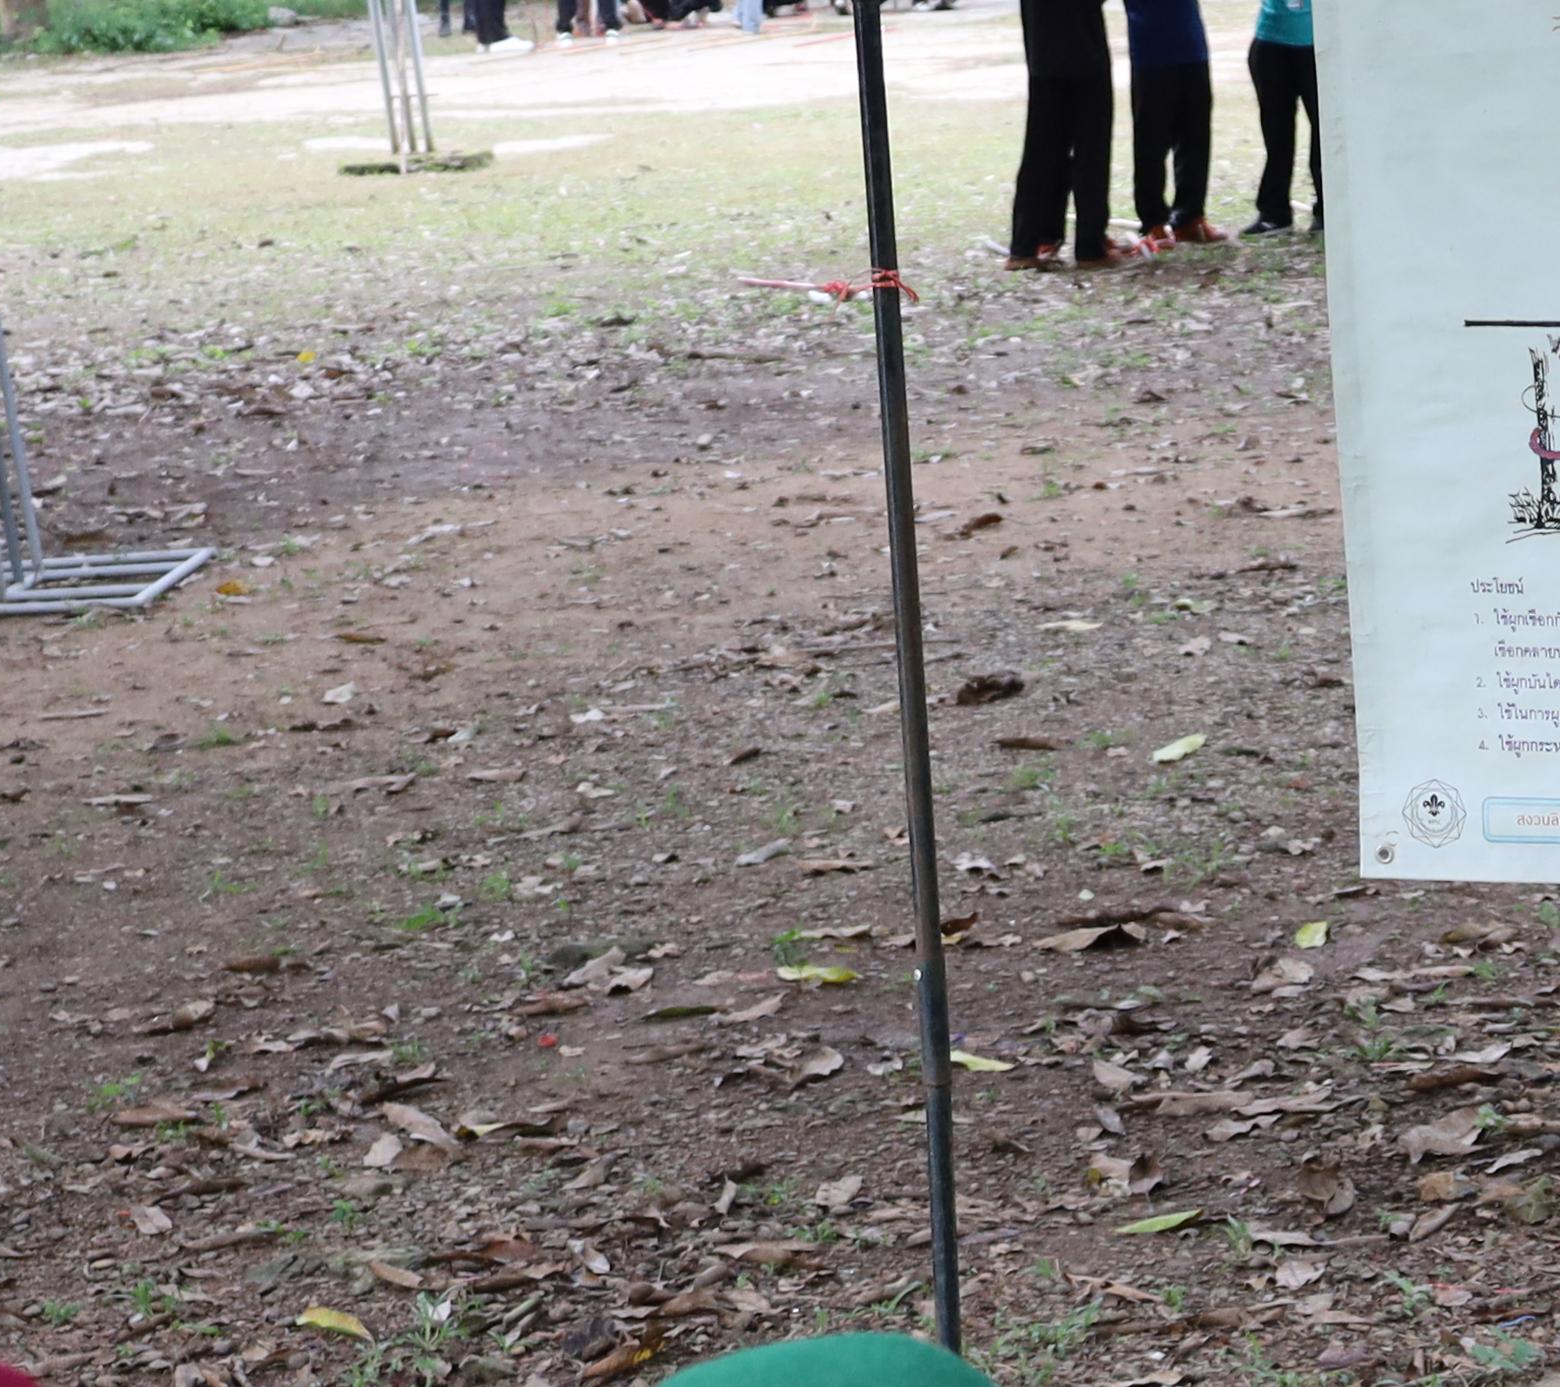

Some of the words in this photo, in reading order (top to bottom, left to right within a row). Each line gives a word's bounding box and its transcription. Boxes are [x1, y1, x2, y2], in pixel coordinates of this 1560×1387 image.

[1470, 577, 1524, 594] ประโยชน์
[1476, 677, 1486, 687] 2.
[1478, 708, 1487, 719] 3.
